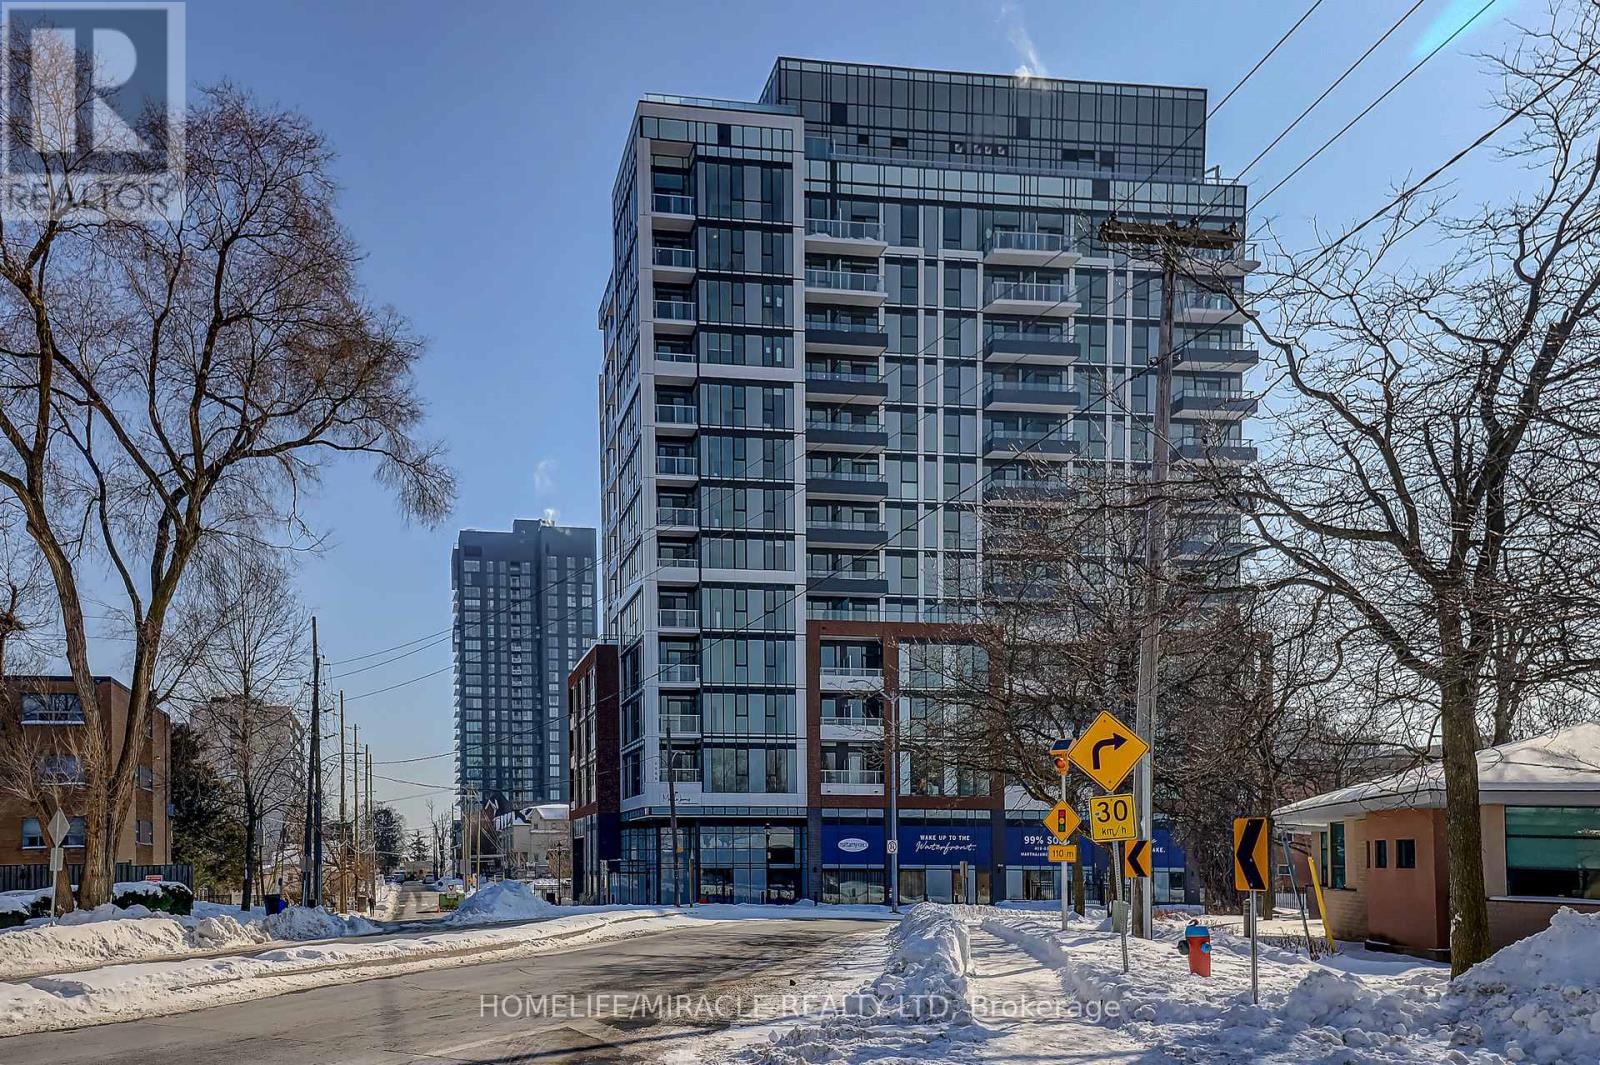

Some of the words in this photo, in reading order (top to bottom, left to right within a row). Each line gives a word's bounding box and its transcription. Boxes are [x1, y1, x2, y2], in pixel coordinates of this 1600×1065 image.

[1097, 800, 1128, 823] 30
[1102, 825, 1127, 837] km/h
[1024, 836, 1044, 845] 99%
[1053, 850, 1064, 858] 110
